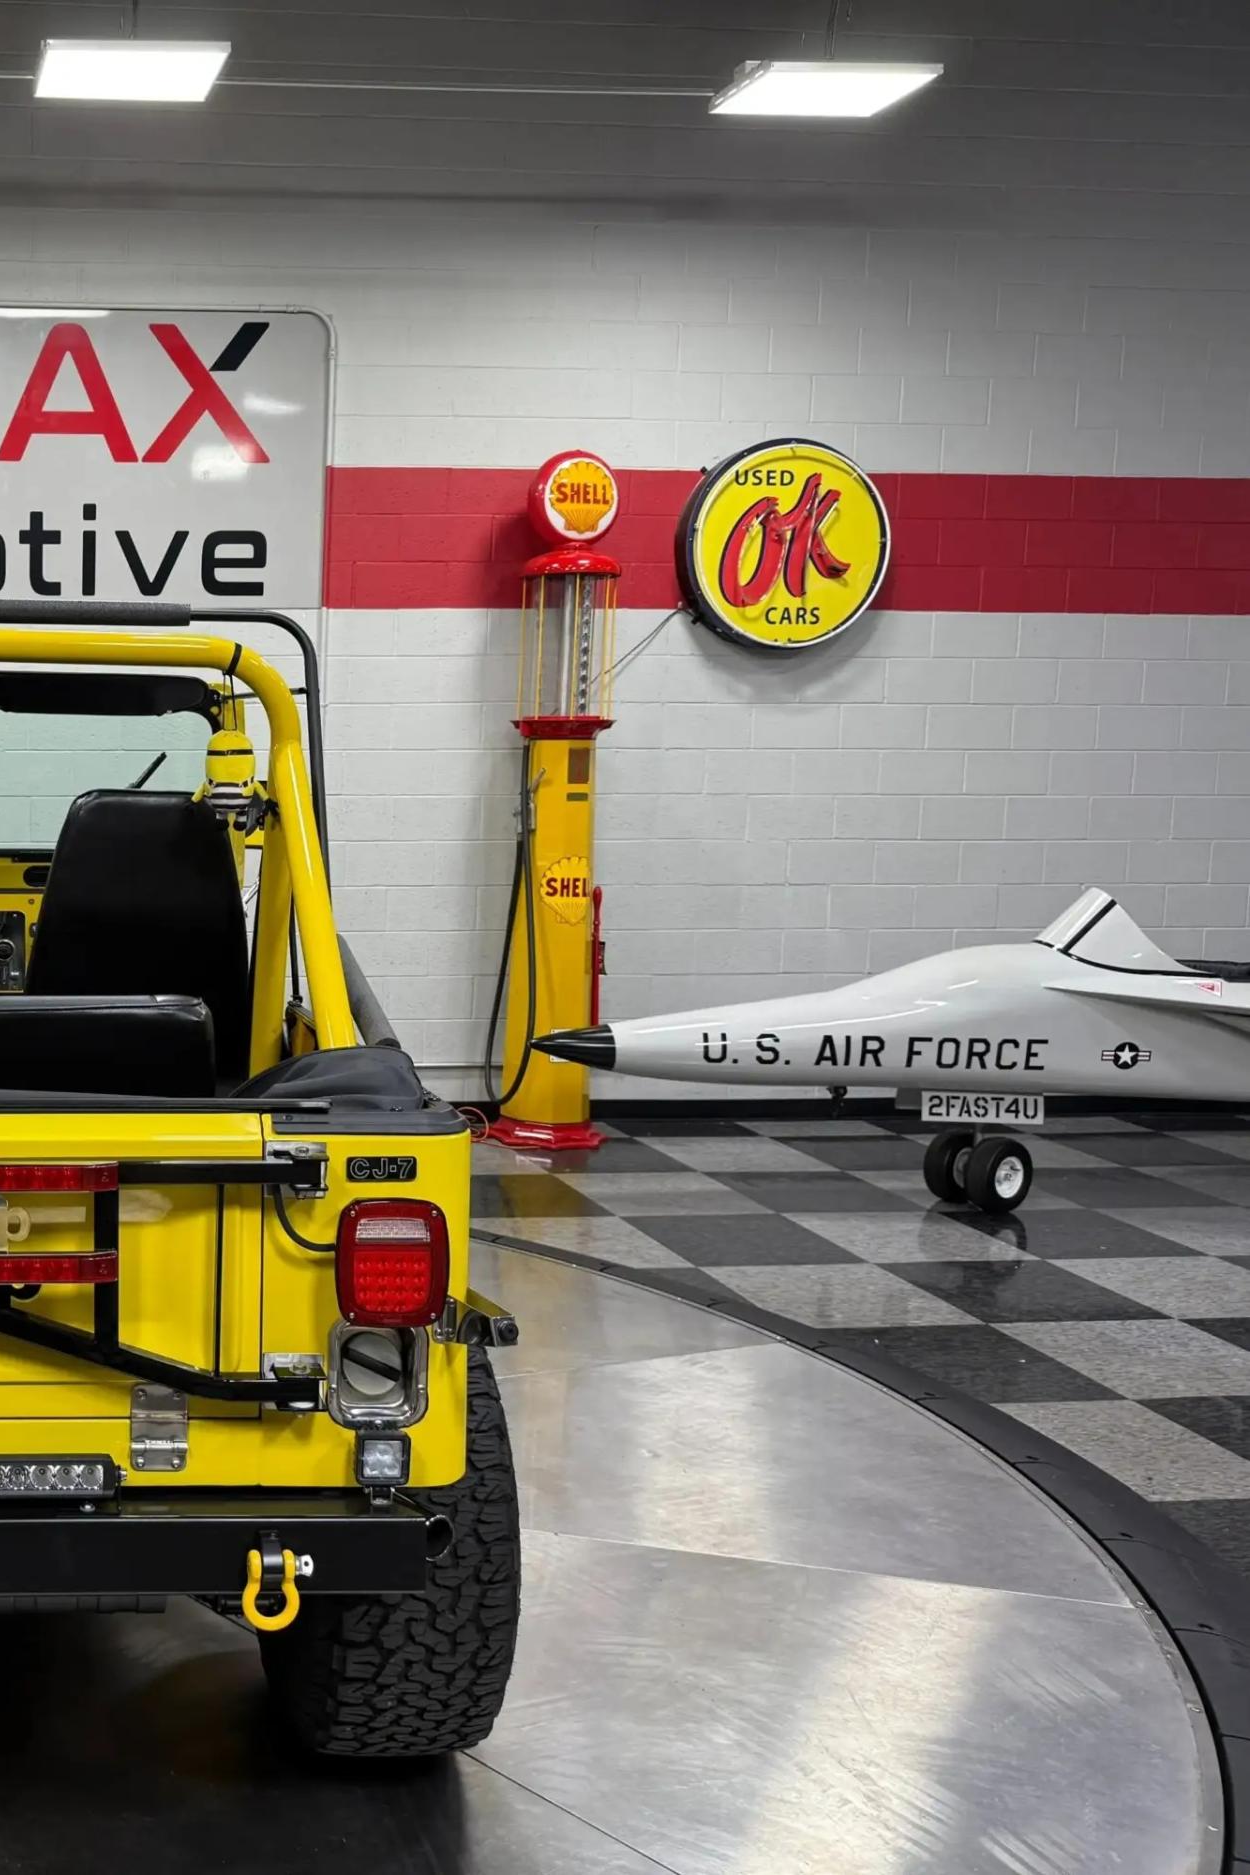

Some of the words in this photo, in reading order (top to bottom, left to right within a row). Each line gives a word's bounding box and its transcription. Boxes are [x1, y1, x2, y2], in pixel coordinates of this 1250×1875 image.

[735, 469, 794, 486] USED
[555, 481, 610, 505] SHELL
[719, 473, 851, 607] OK
[765, 607, 820, 626] CARS
[703, 1033, 738, 1065] U.
[755, 1035, 791, 1065] S.
[815, 1035, 885, 1068] AIR
[905, 1039, 1049, 1071] FORCE
[927, 1095, 1039, 1121] 2FAST4U
